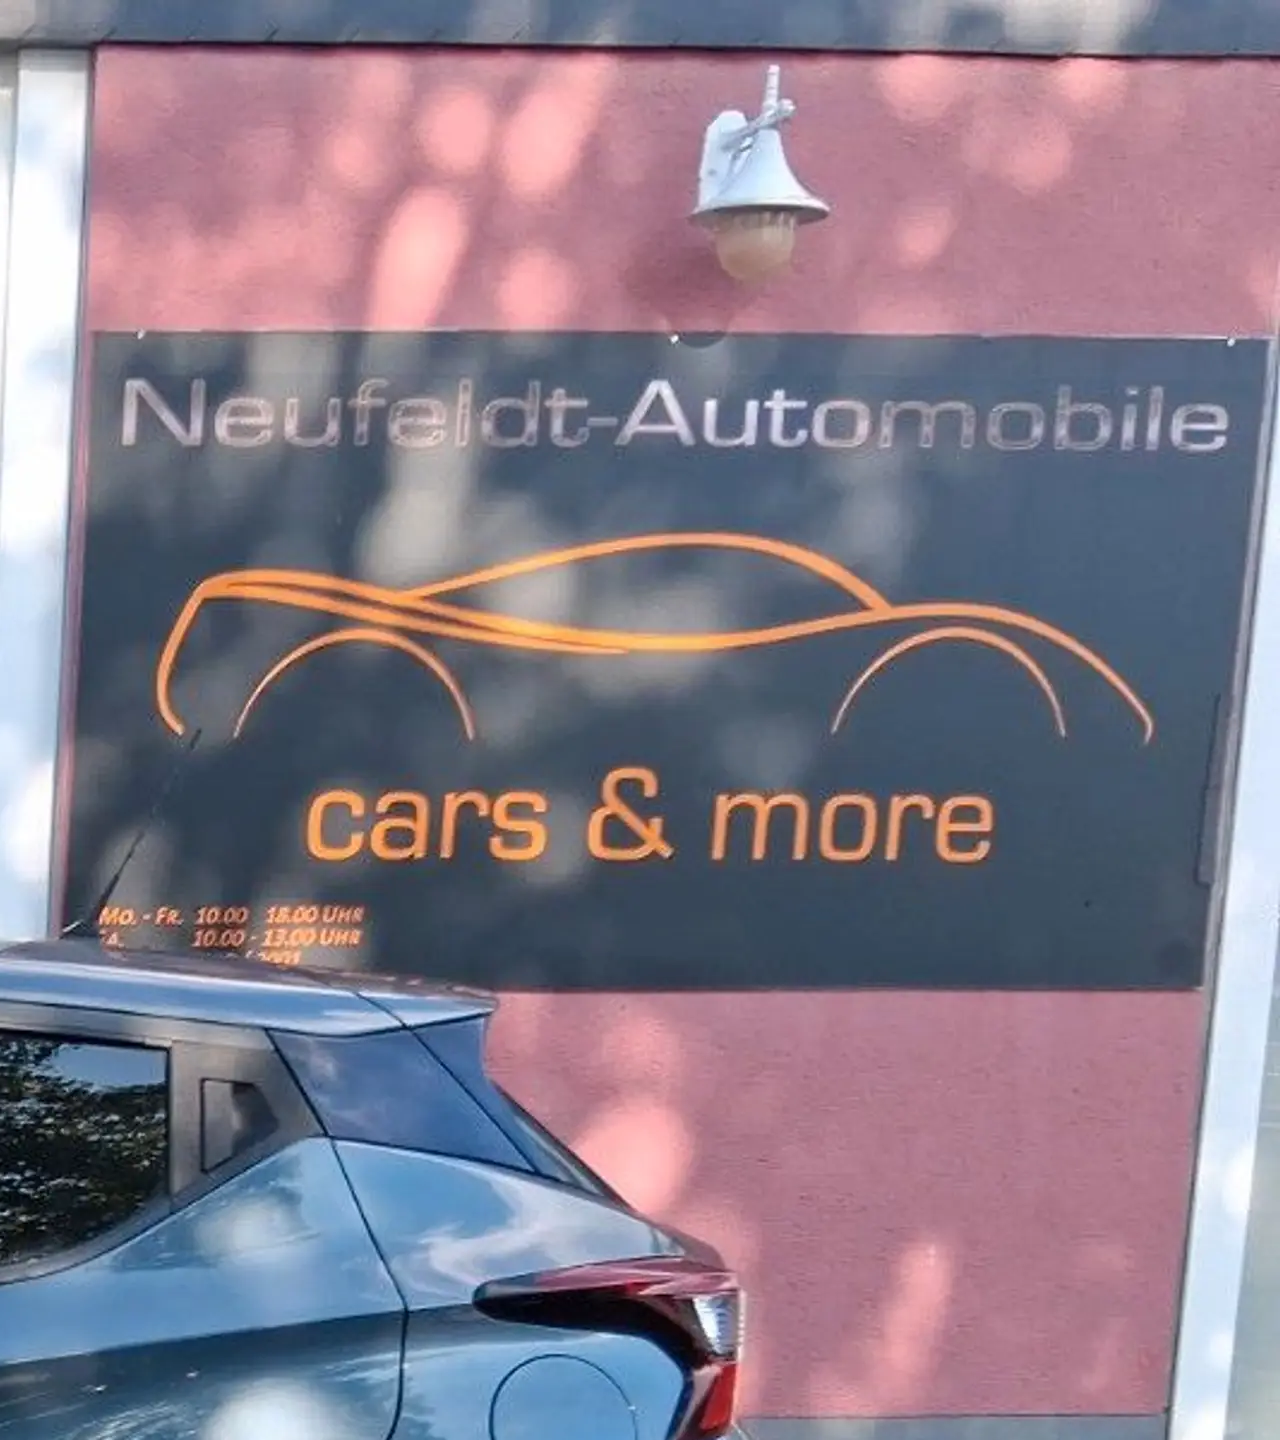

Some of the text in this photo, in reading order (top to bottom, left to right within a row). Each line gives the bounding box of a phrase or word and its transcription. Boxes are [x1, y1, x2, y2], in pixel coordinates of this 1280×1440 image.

[121, 377, 1231, 452] Neufeldt-Automobile
[306, 767, 994, 864] cars & more
[191, 928, 246, 947] 10.00
[194, 905, 250, 926] 10.00
